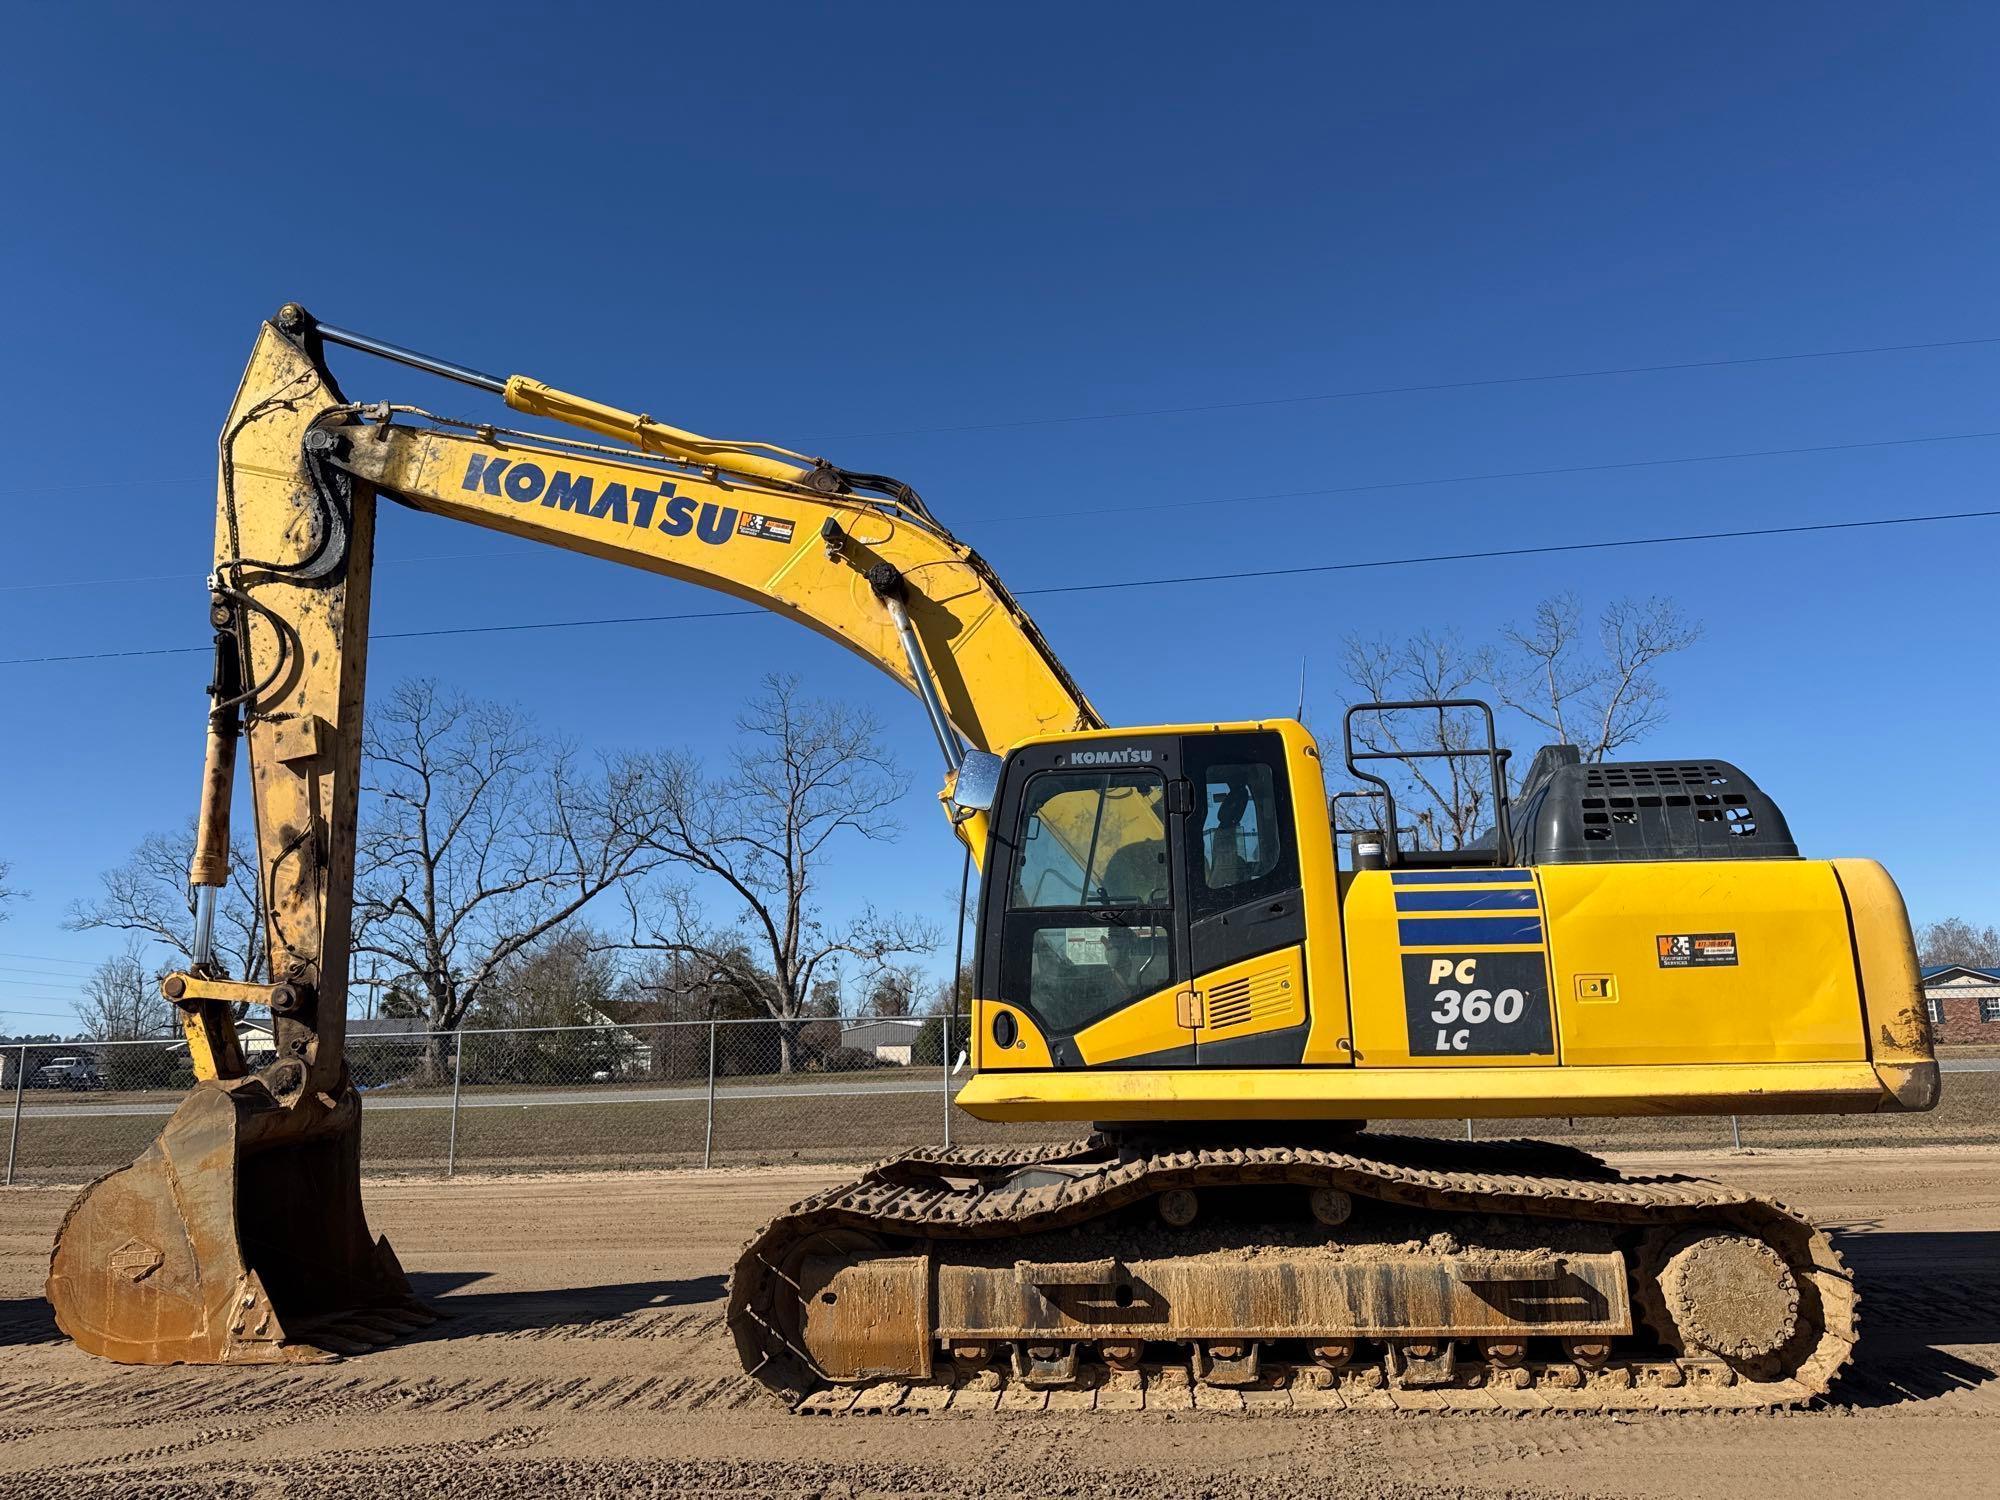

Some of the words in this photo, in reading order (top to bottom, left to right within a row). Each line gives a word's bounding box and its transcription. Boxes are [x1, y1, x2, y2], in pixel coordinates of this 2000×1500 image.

[461, 453, 740, 545] KOMATSU
[1071, 747, 1152, 764] KOMATSU
[1429, 958, 1476, 984] PC
[1431, 988, 1524, 1024] 360
[1435, 1029, 1470, 1050] LC
